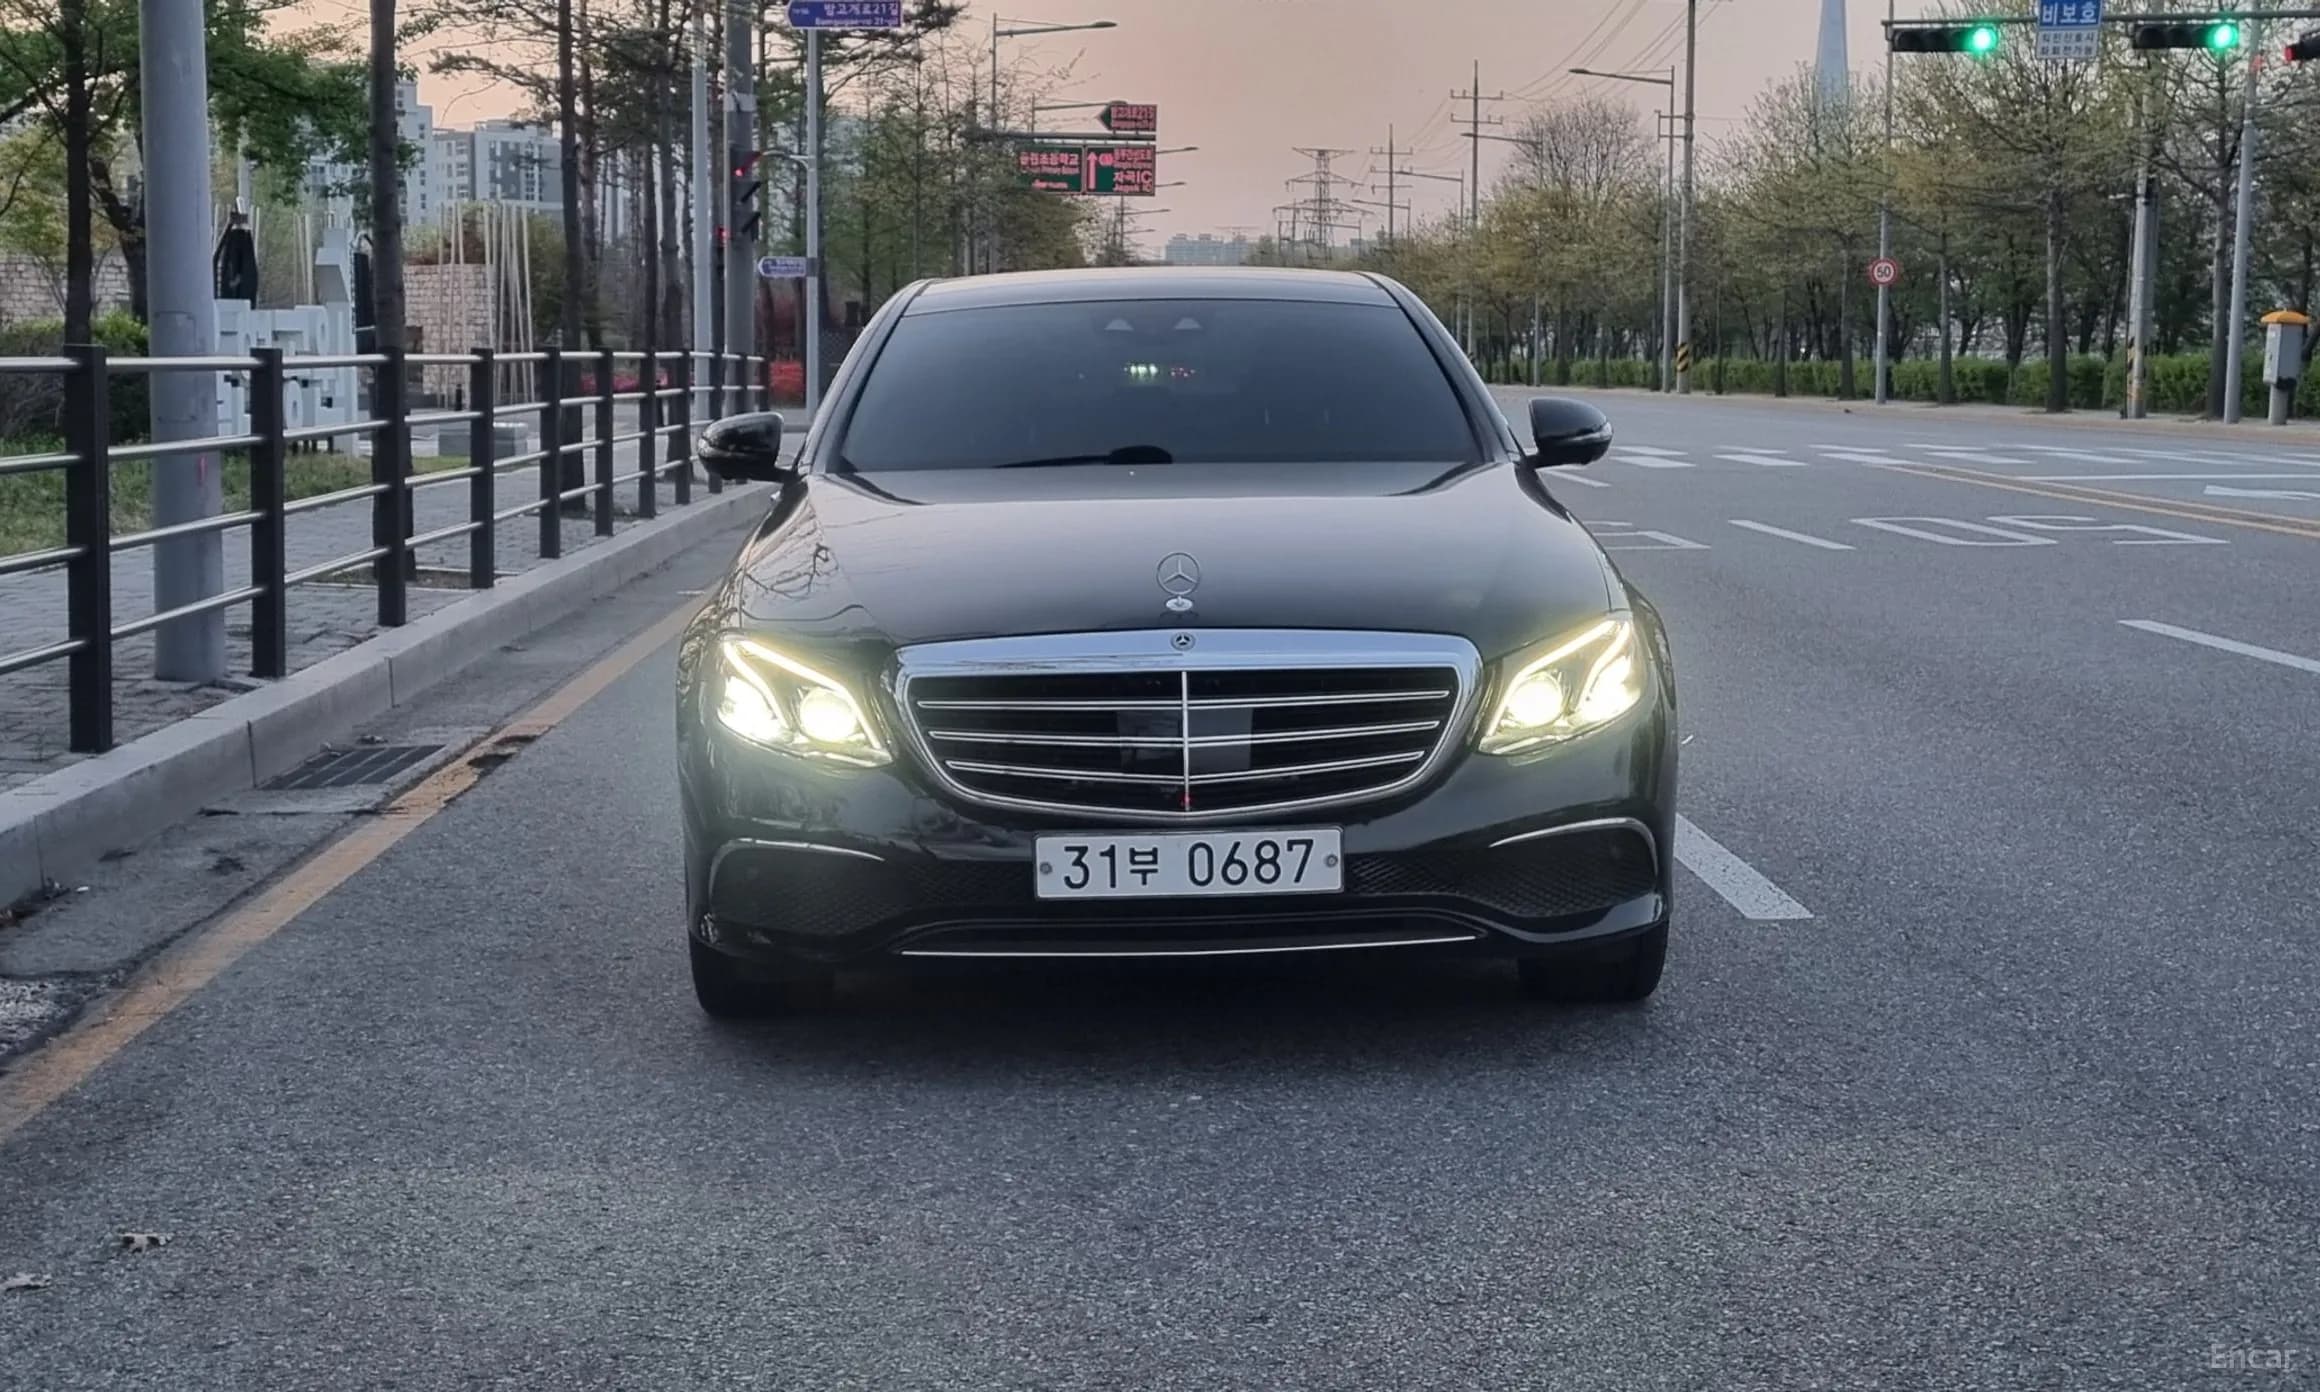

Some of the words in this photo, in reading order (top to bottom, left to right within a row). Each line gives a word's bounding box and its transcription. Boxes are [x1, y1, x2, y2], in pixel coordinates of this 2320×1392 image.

[2042, 2, 2097, 25] 비보호
[1063, 843, 1159, 889] 31부
[1187, 838, 1314, 887] 0687
